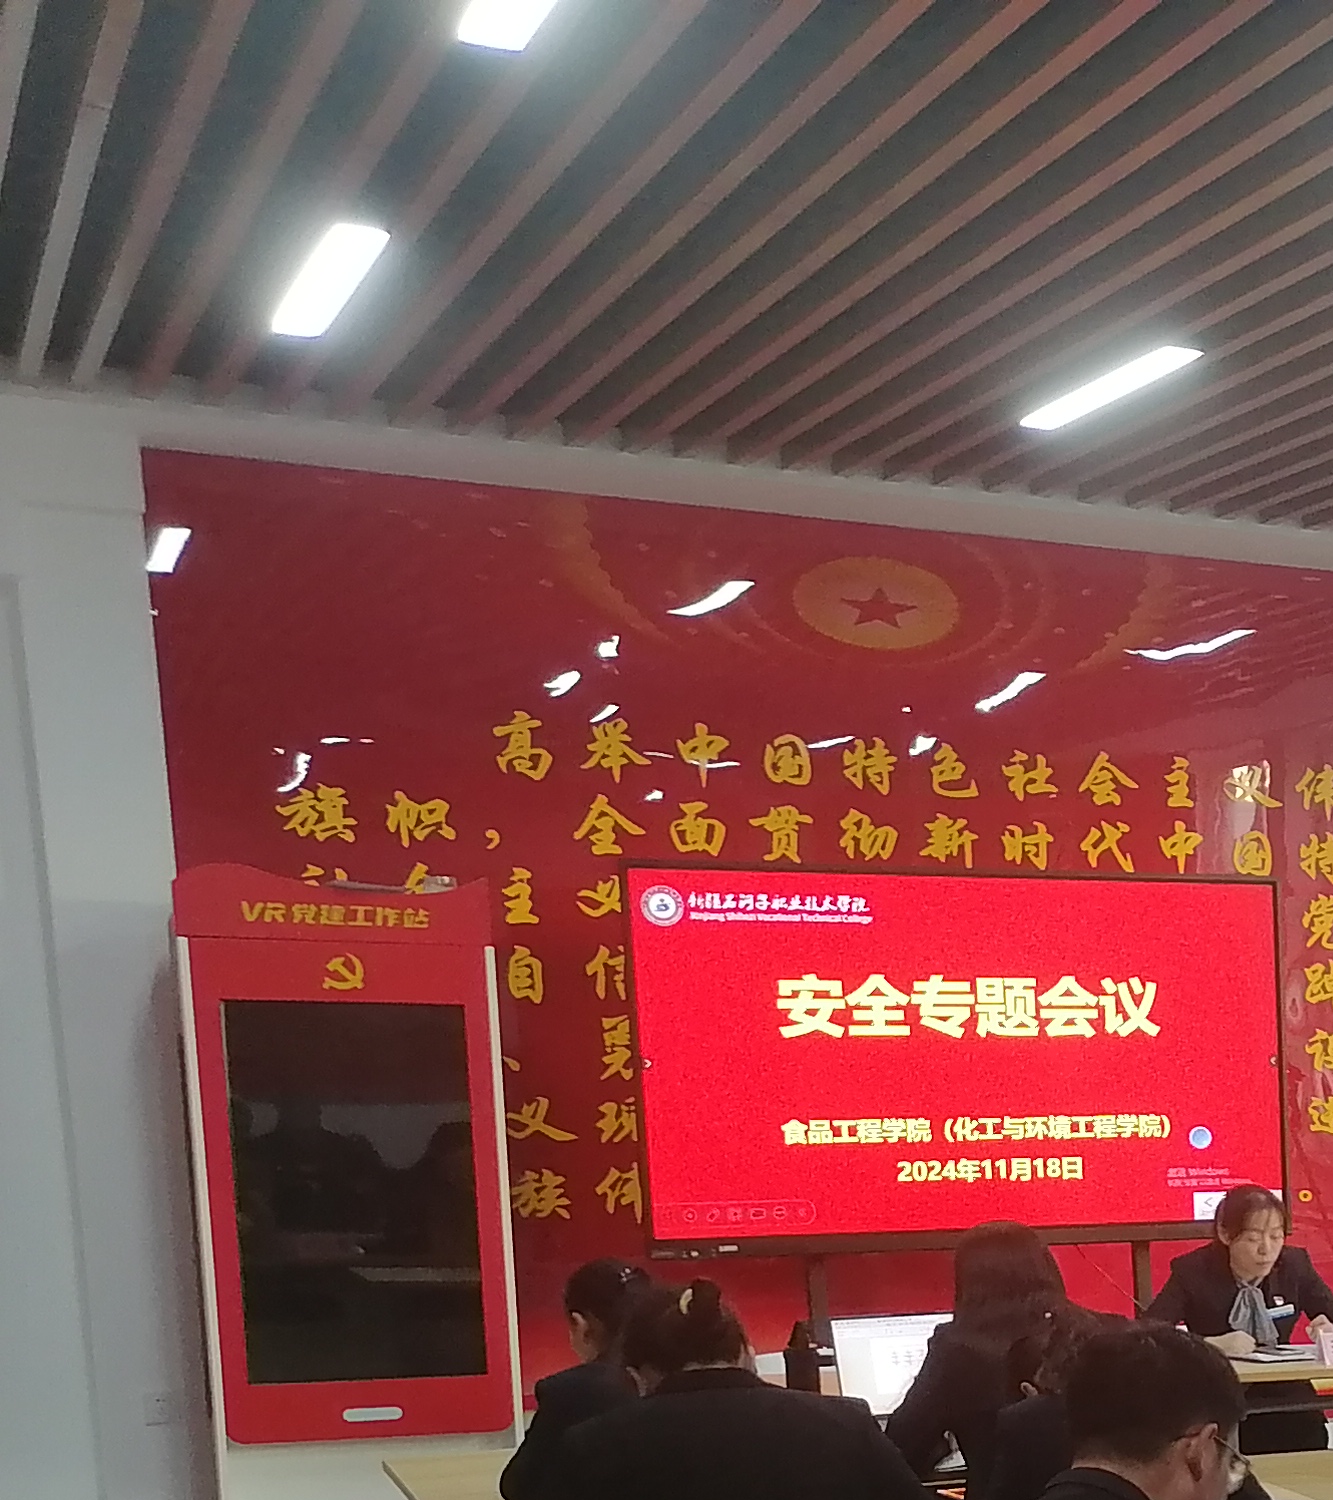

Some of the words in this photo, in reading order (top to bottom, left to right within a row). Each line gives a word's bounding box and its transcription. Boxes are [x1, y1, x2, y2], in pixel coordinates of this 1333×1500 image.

[776, 973, 1161, 1039] 安全专题会议
[780, 1113, 1171, 1146] 食品工程学院（化工与环境工程学院）
[897, 1156, 1084, 1183] 2024年11月18日
